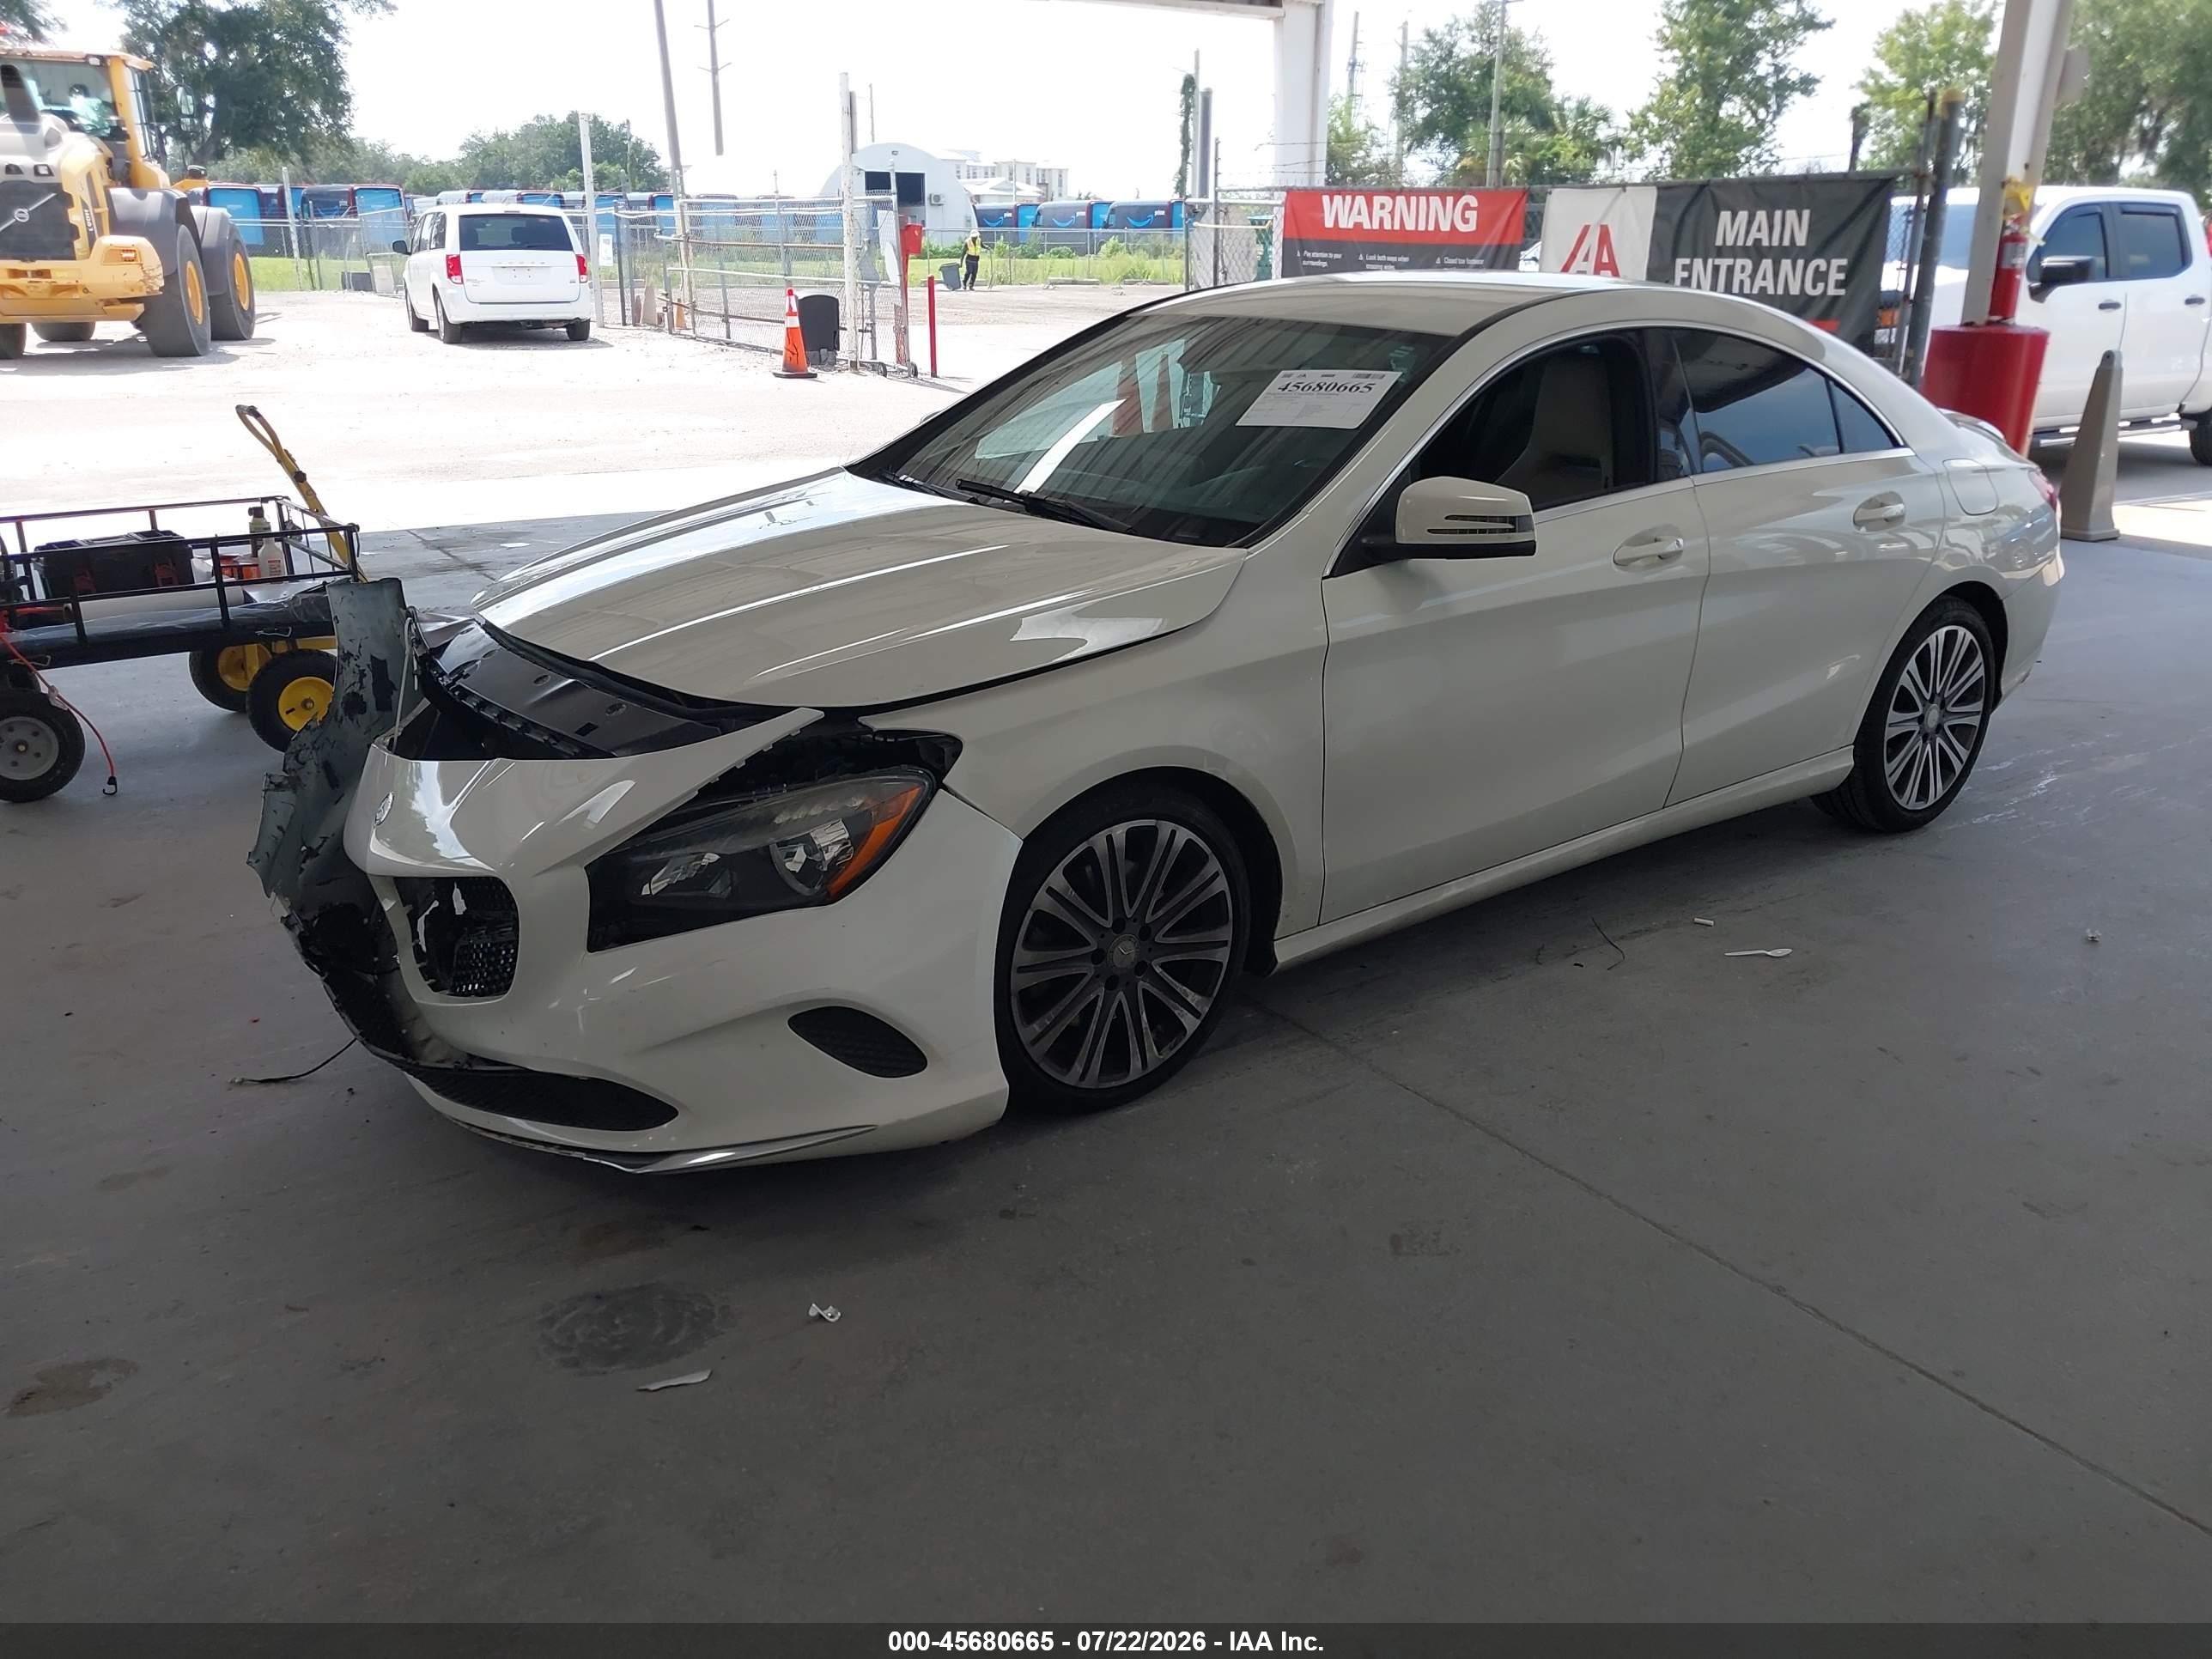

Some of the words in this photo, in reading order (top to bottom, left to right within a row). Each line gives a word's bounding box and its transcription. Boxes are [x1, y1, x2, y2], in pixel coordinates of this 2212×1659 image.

[1322, 194, 1479, 233] WARNING
[1715, 209, 1810, 246] MAIN
[1674, 258, 1848, 295] ENTRANCE
[1277, 381, 1376, 393] 45680665
